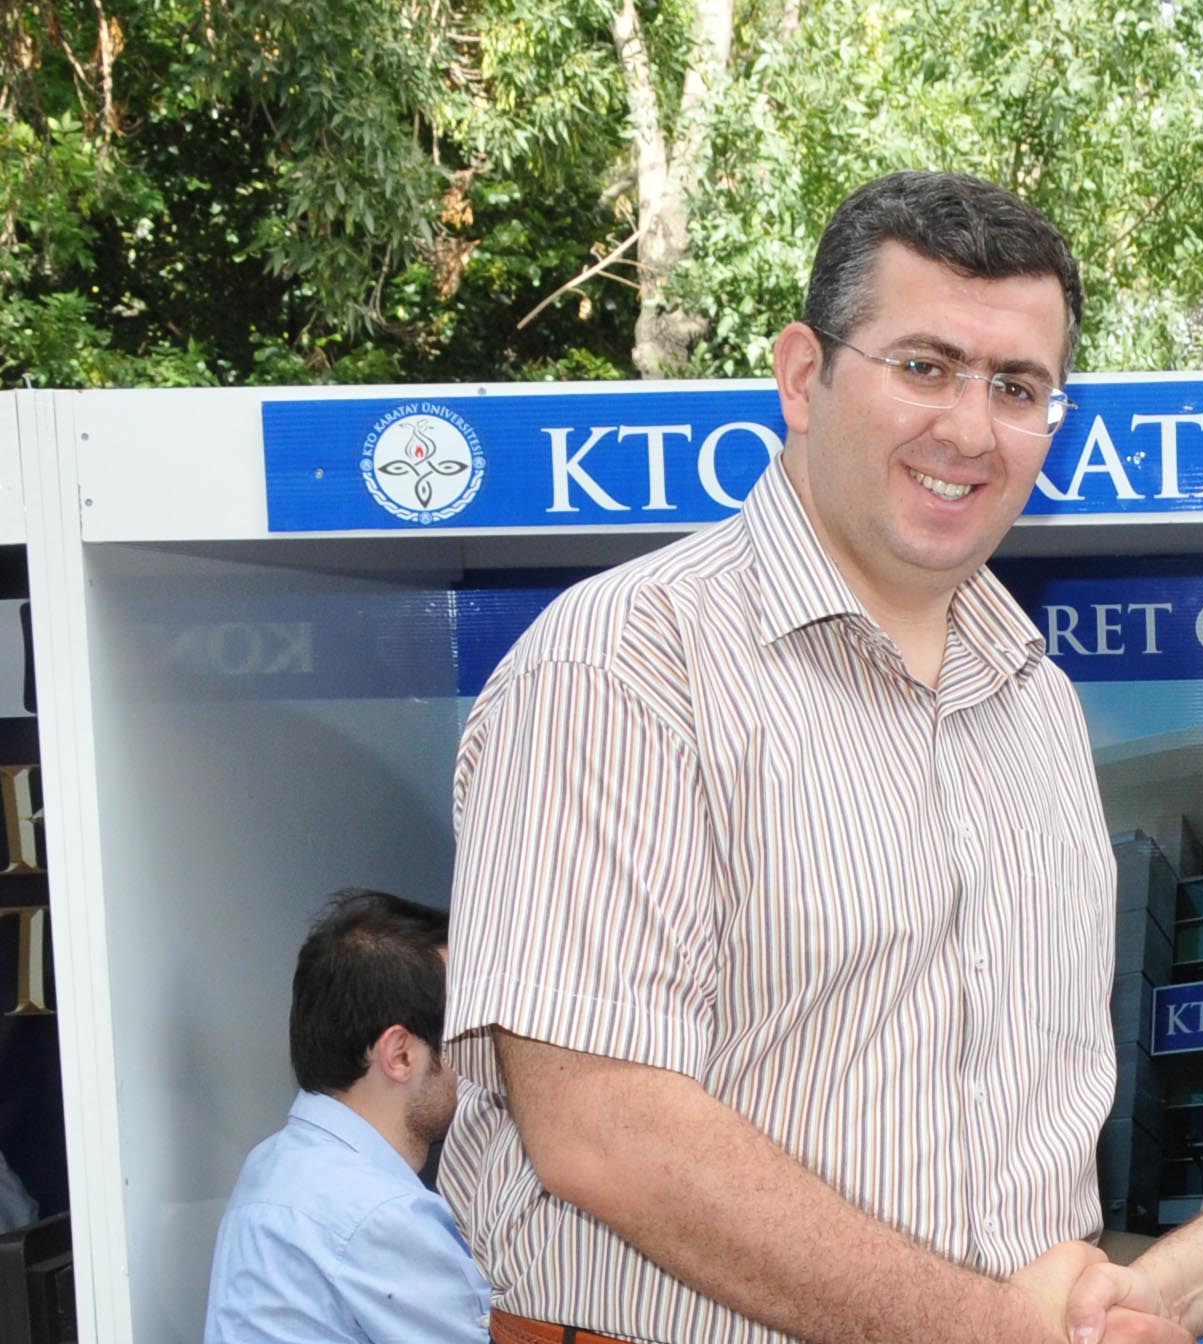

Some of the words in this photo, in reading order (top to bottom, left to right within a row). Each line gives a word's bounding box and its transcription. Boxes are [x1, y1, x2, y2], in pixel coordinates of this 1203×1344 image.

[362, 432, 378, 457] KTO
[373, 402, 419, 433] KARATAY
[541, 419, 785, 513] KTO
